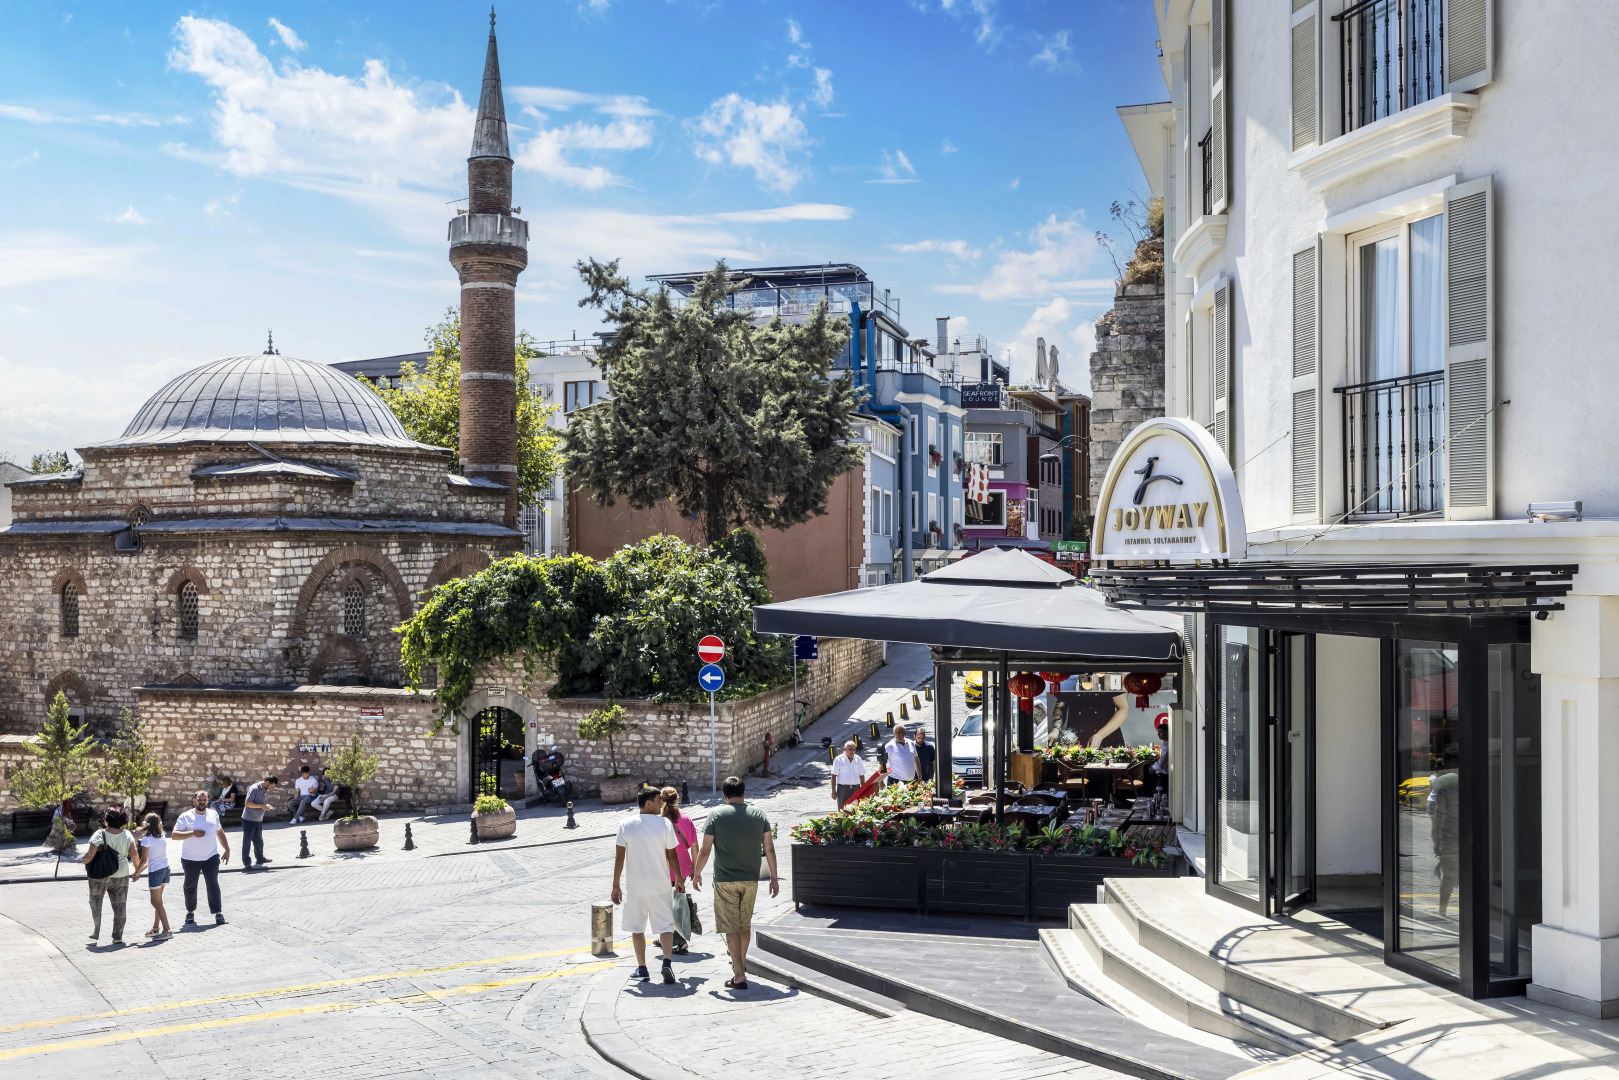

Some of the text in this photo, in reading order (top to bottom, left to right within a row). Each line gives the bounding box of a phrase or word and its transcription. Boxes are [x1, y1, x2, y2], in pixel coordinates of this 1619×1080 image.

[1112, 502, 1208, 531] JOYWAY
[1125, 536, 1196, 545] ISTANBUL SULTANAHMET
